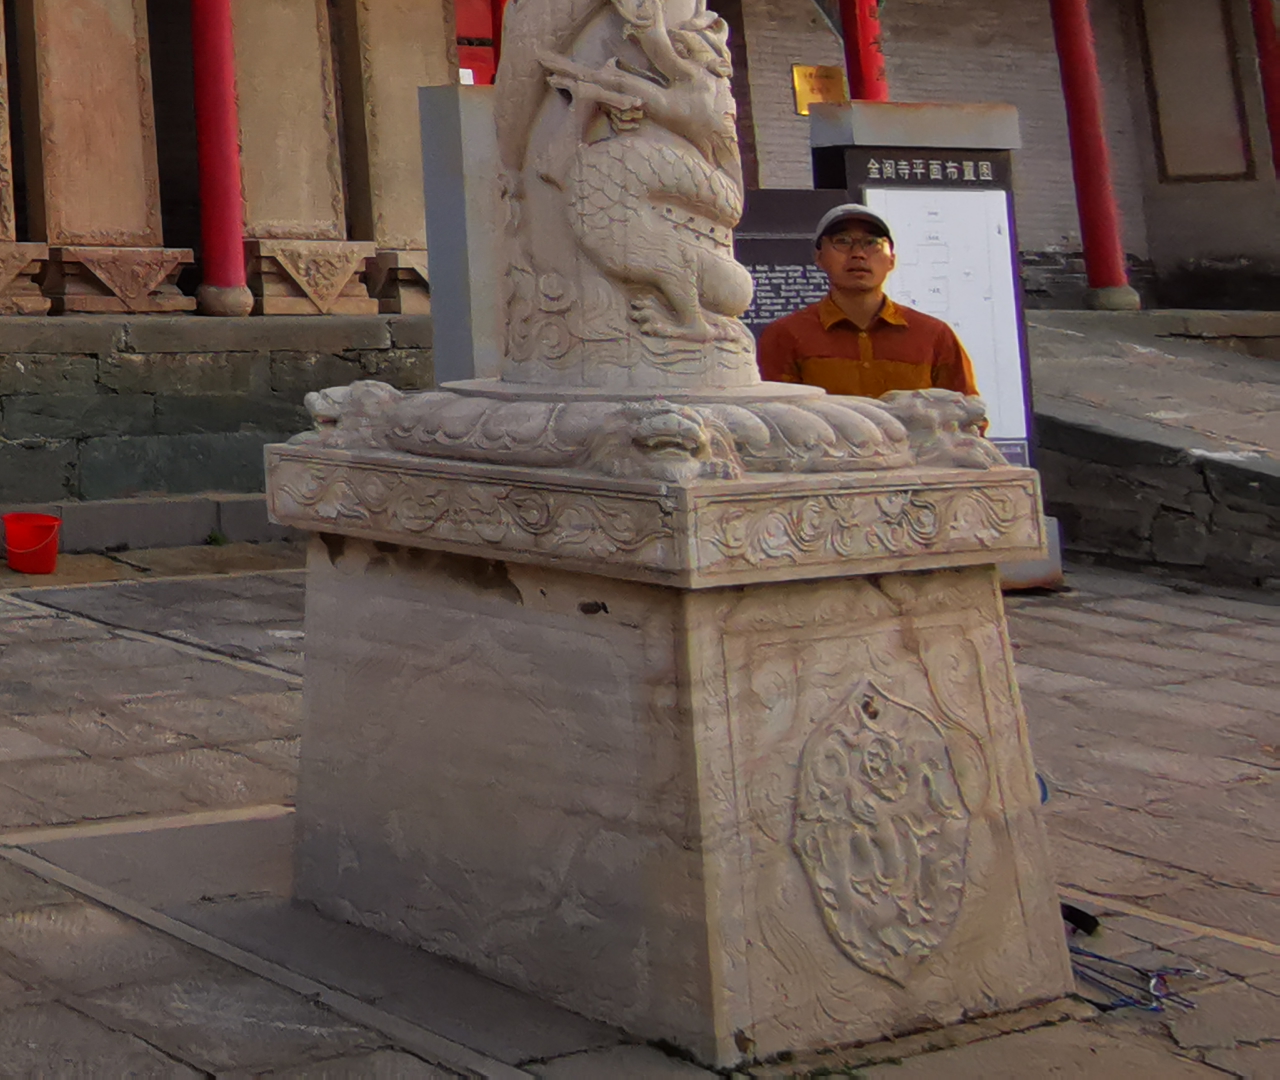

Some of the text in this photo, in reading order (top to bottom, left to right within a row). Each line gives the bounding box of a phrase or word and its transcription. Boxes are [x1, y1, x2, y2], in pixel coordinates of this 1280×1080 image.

[867, 158, 993, 180] 金阁寺平面布置图
